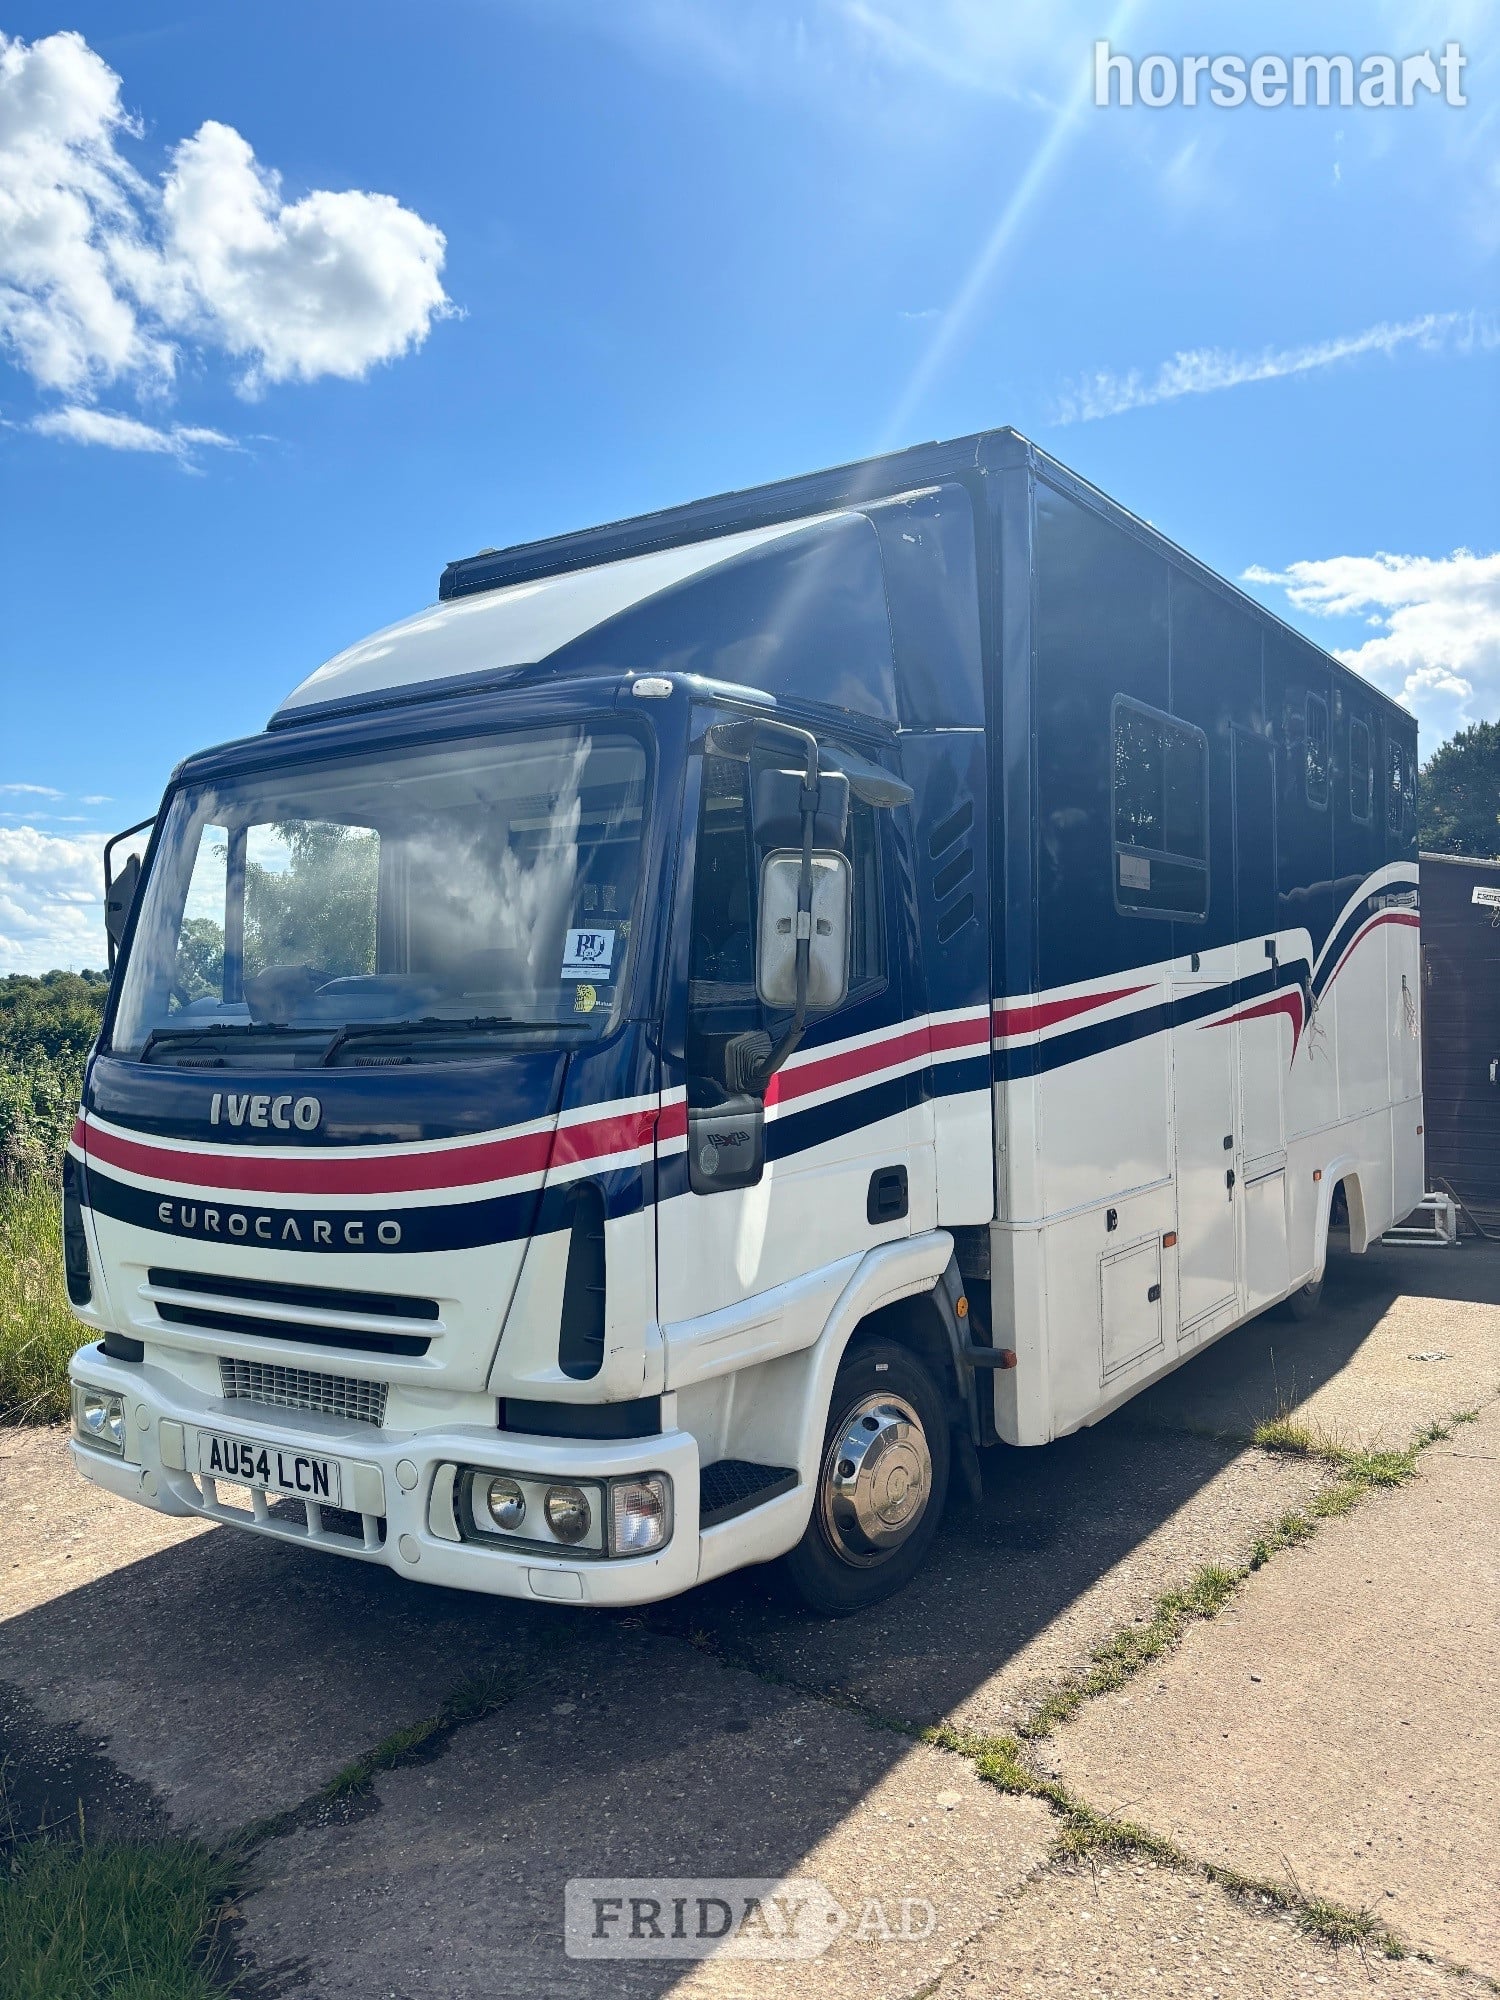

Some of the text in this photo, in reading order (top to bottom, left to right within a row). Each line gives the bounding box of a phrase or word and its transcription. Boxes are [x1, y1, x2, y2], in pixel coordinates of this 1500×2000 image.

[210, 1093, 322, 1131] IVECO
[158, 1202, 401, 1245] EUROCARGO
[210, 1438, 329, 1496] AU54 LCN
